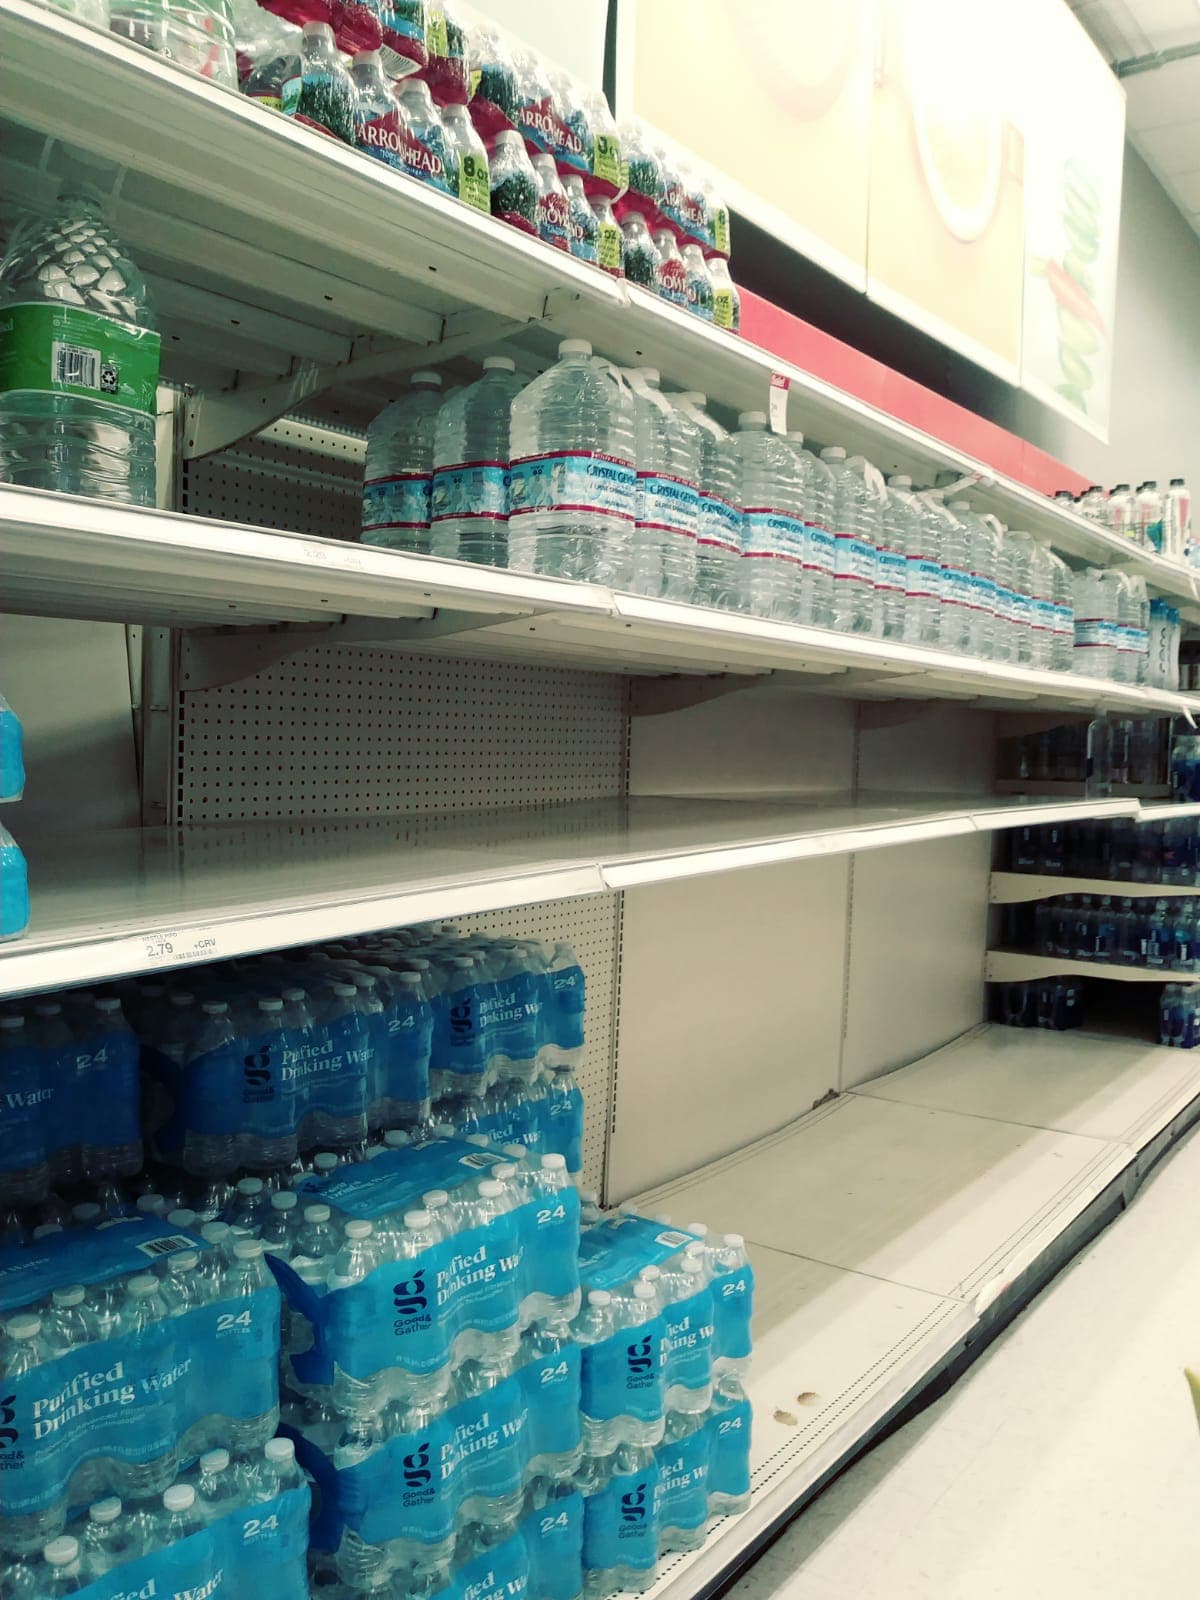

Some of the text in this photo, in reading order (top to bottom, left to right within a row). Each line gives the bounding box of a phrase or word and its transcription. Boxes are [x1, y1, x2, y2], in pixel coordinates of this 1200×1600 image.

[464, 156, 475, 176] 8
[147, 942, 174, 957] 2.79
[193, 938, 217, 950] +CRV
[554, 974, 577, 990] 24
[388, 1016, 415, 1033] 24
[75, 1049, 109, 1070] 24
[550, 1102, 574, 1116] 24
[536, 1205, 567, 1224] 24
[721, 1279, 746, 1297] 24
[216, 1310, 252, 1331] 24
[394, 1323, 432, 1337] Gather
[541, 1362, 569, 1383] 24
[33, 1361, 125, 1418] Purified
[33, 1384, 136, 1440] Drinking
[140, 1358, 192, 1394] Water
[719, 1417, 742, 1434] 24
[243, 1515, 279, 1538] 24
[540, 1511, 569, 1534] 24
